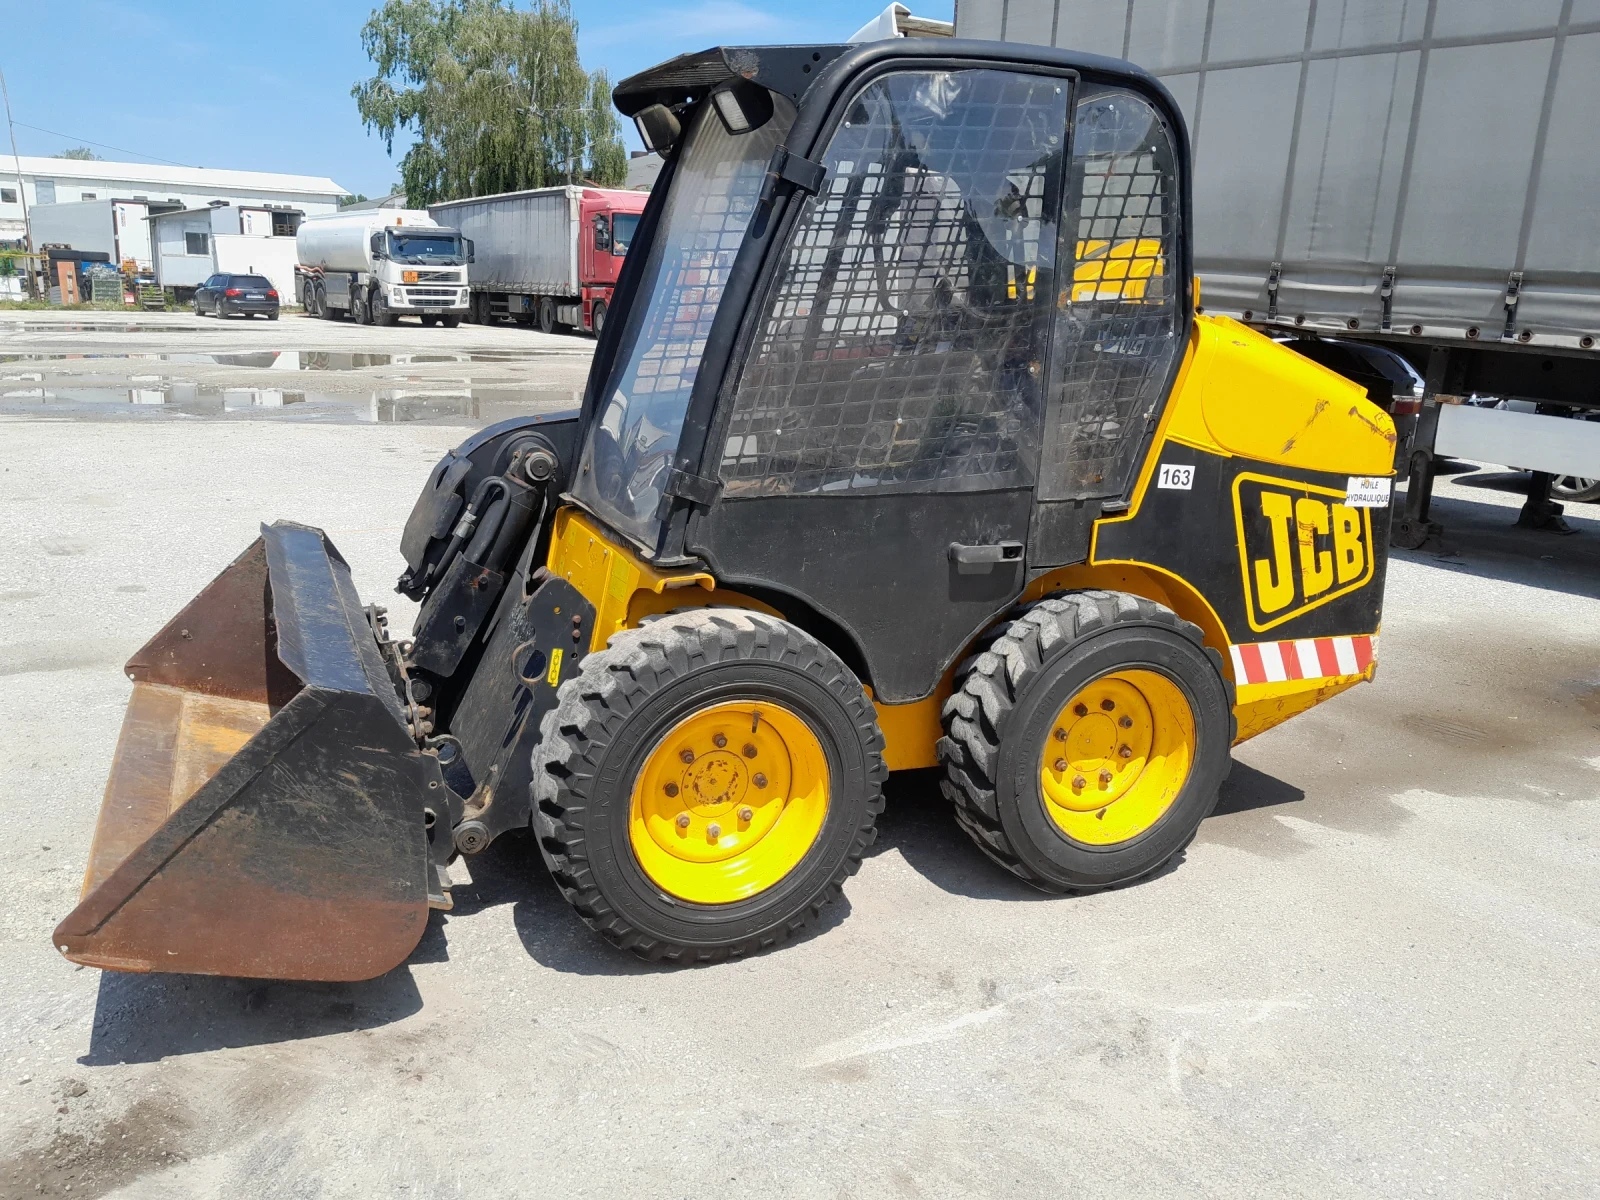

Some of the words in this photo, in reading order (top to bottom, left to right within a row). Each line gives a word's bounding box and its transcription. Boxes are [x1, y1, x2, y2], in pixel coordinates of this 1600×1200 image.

[1163, 468, 1191, 486] 163
[1360, 480, 1379, 490] HUILE
[1346, 493, 1390, 504] HYDRAULIQUE
[1255, 491, 1364, 613] JCB
[591, 666, 728, 831] MICHELIN
